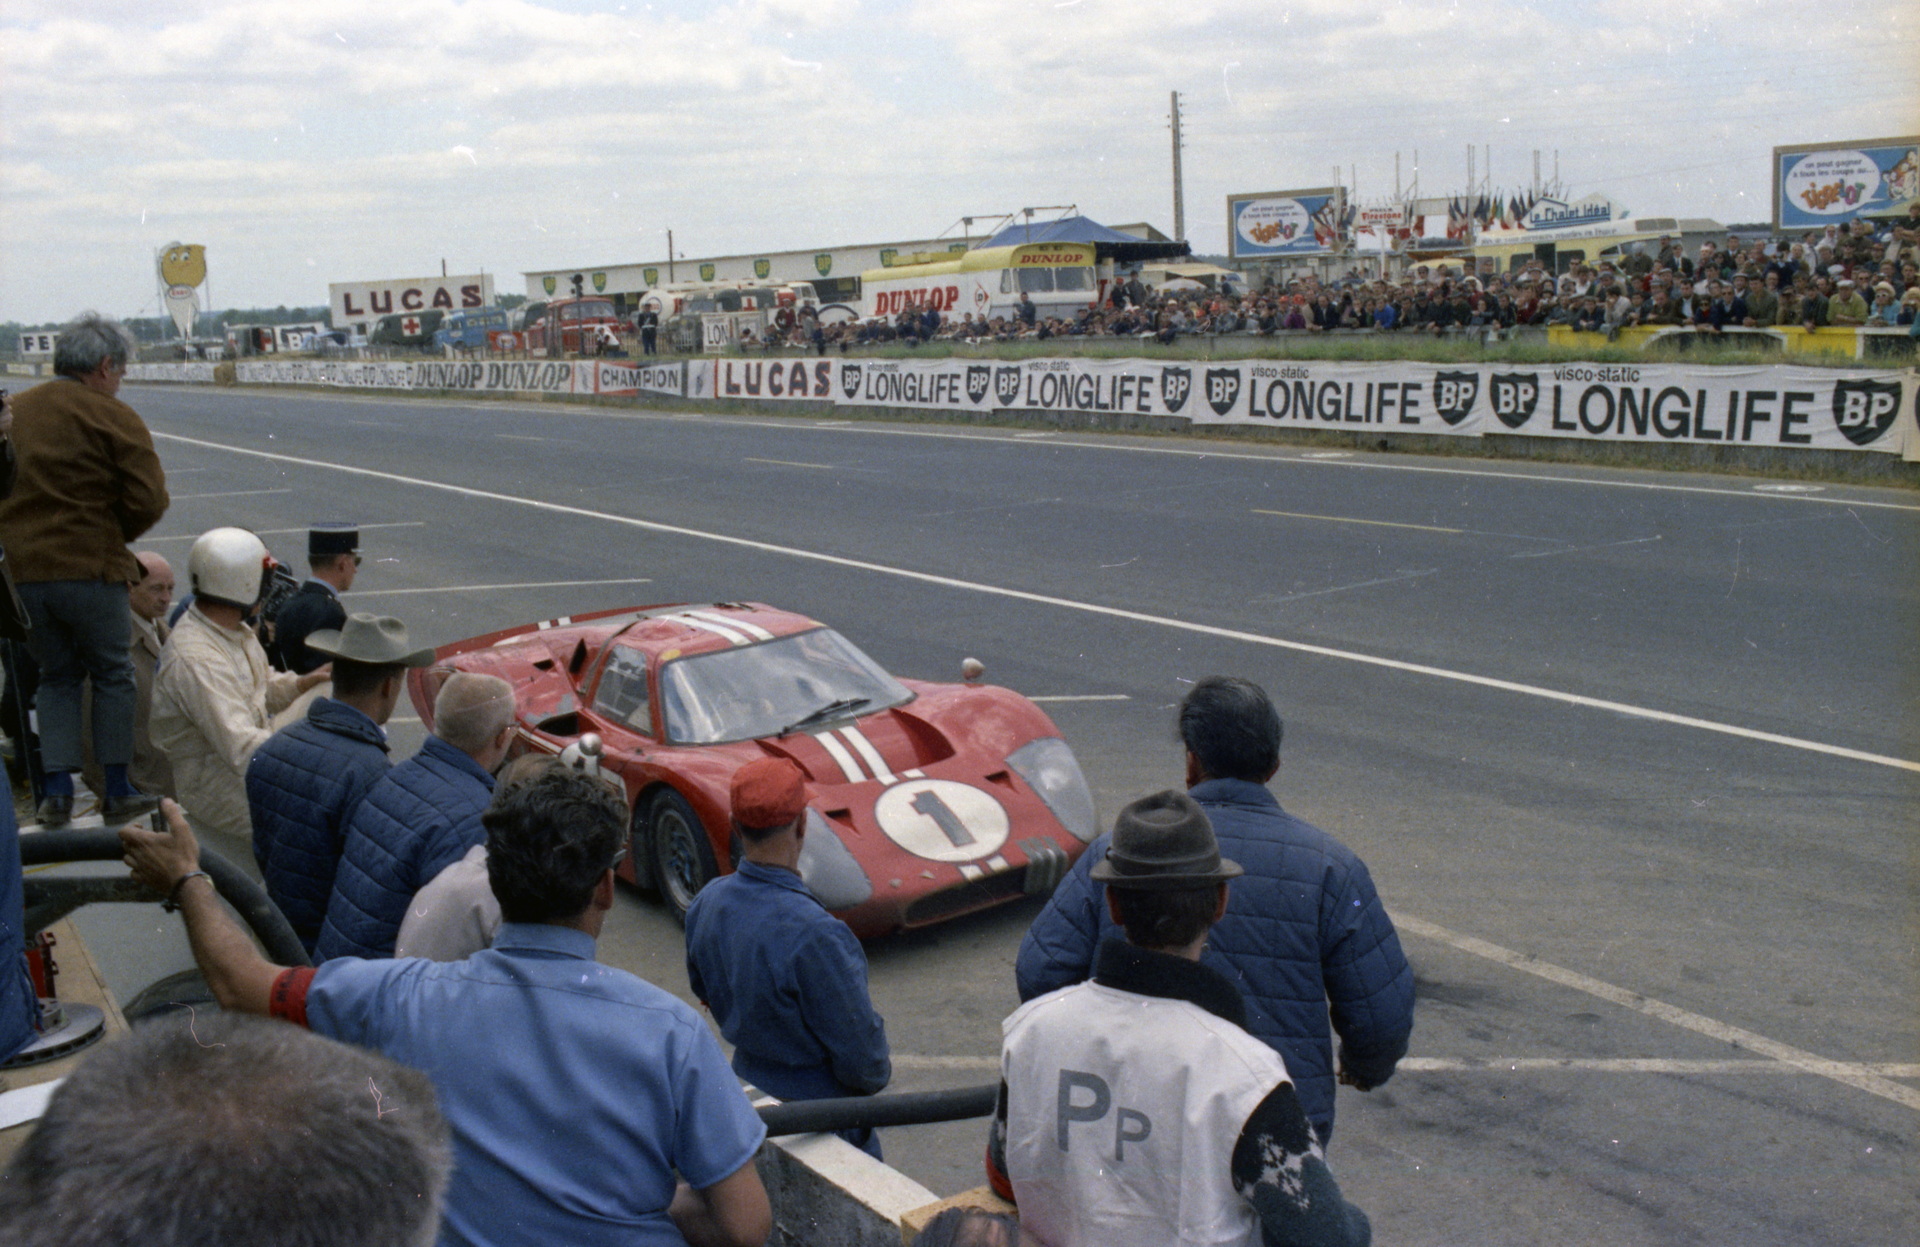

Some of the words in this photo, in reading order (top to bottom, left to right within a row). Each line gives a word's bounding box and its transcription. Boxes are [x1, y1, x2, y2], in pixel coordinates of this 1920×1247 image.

[1361, 212, 1402, 220] Firestone
[1020, 254, 1083, 264] DUNLOP
[343, 284, 483, 315] LUCAS
[875, 285, 959, 317] DUNLOP
[415, 362, 483, 388] DUNLOP
[486, 362, 571, 391] DUNLOP
[602, 369, 679, 388] CHAMPION
[725, 360, 831, 397] LUCAS
[844, 370, 861, 390] BP
[866, 372, 961, 404] LONGLIFE
[969, 372, 990, 395] BP
[998, 373, 1018, 396] BP
[1026, 373, 1154, 412] LONGLIFE
[1165, 374, 1189, 401] BP
[1210, 376, 1238, 404] BP
[1249, 379, 1422, 425] LONGLIFE
[1438, 380, 1473, 411] BP
[1498, 382, 1535, 414] BP
[1552, 384, 1815, 445] LONGLIFE
[1843, 389, 1895, 430] BP
[908, 789, 977, 848] 1
